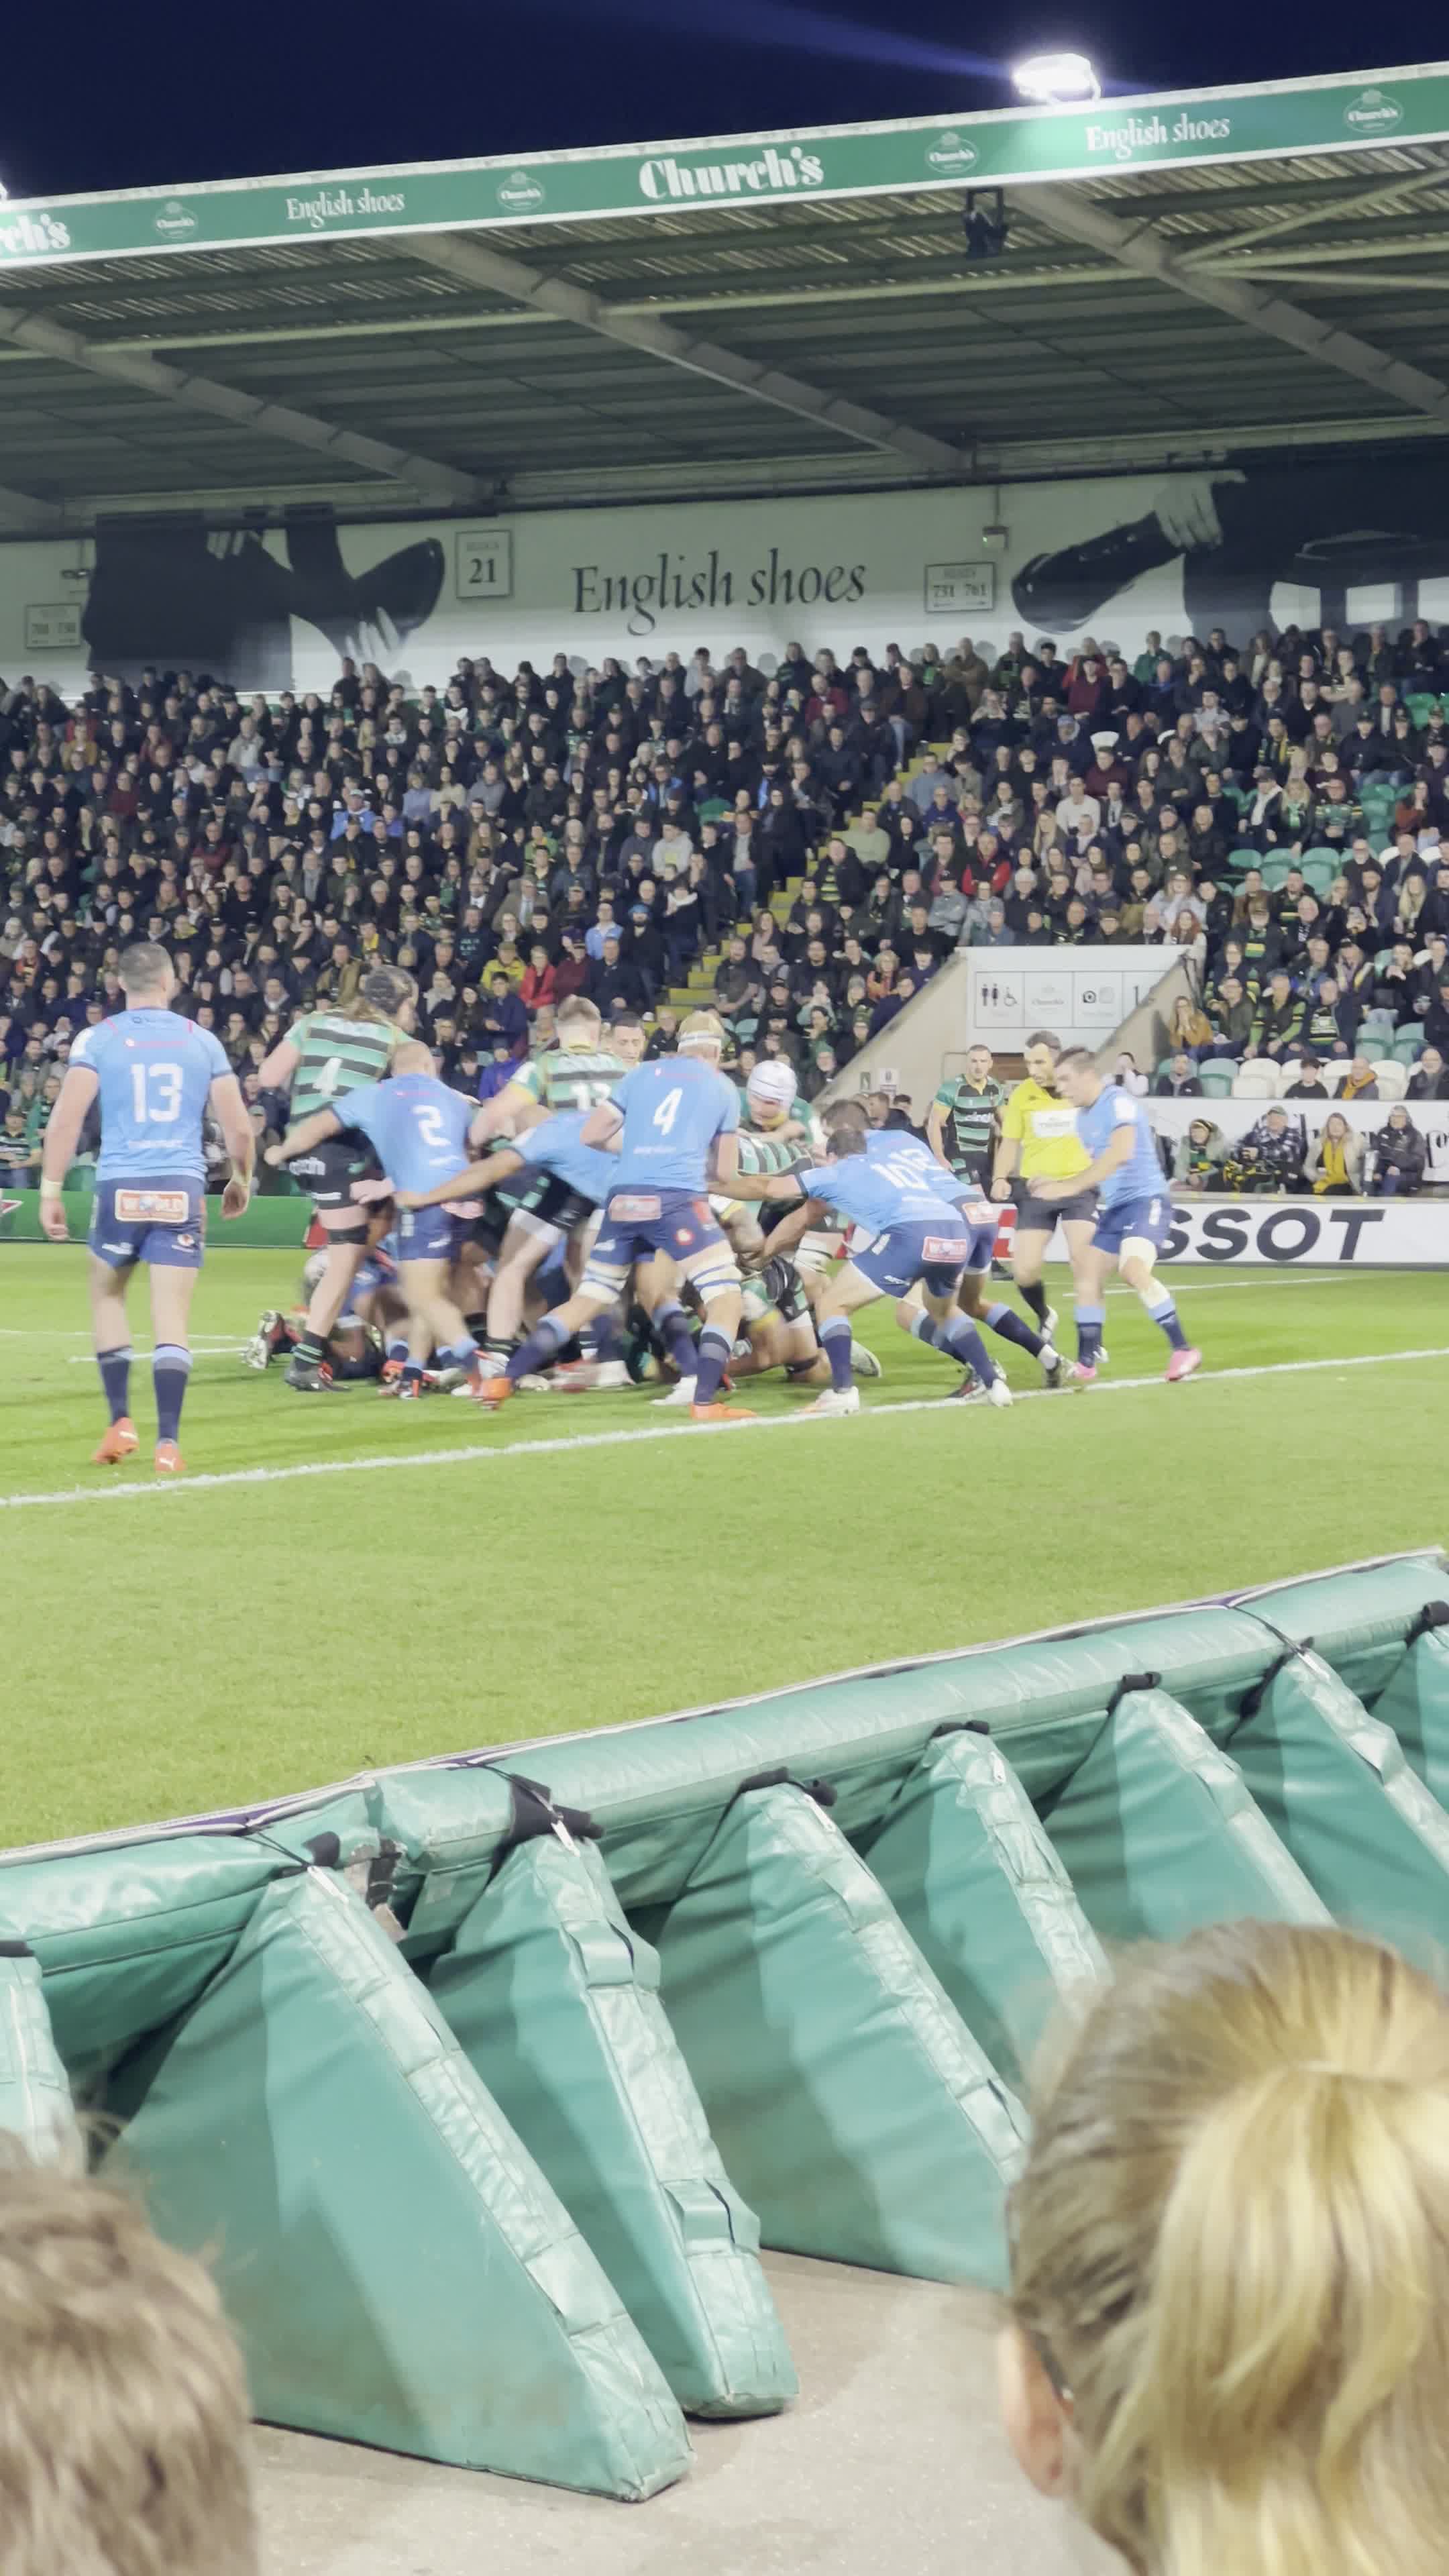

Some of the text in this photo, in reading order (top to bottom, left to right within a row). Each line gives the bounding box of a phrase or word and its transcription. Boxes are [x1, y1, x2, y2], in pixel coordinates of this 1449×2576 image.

[1085, 113, 1231, 160] English shoes
[639, 146, 824, 199] Church's
[286, 187, 406, 228] English shoes
[469, 557, 497, 584] 21
[572, 547, 866, 636] English shoes
[130, 1063, 183, 1122] 13
[653, 1086, 684, 1136] 4
[413, 1105, 451, 1146] 2
[869, 1163, 930, 1191] 10
